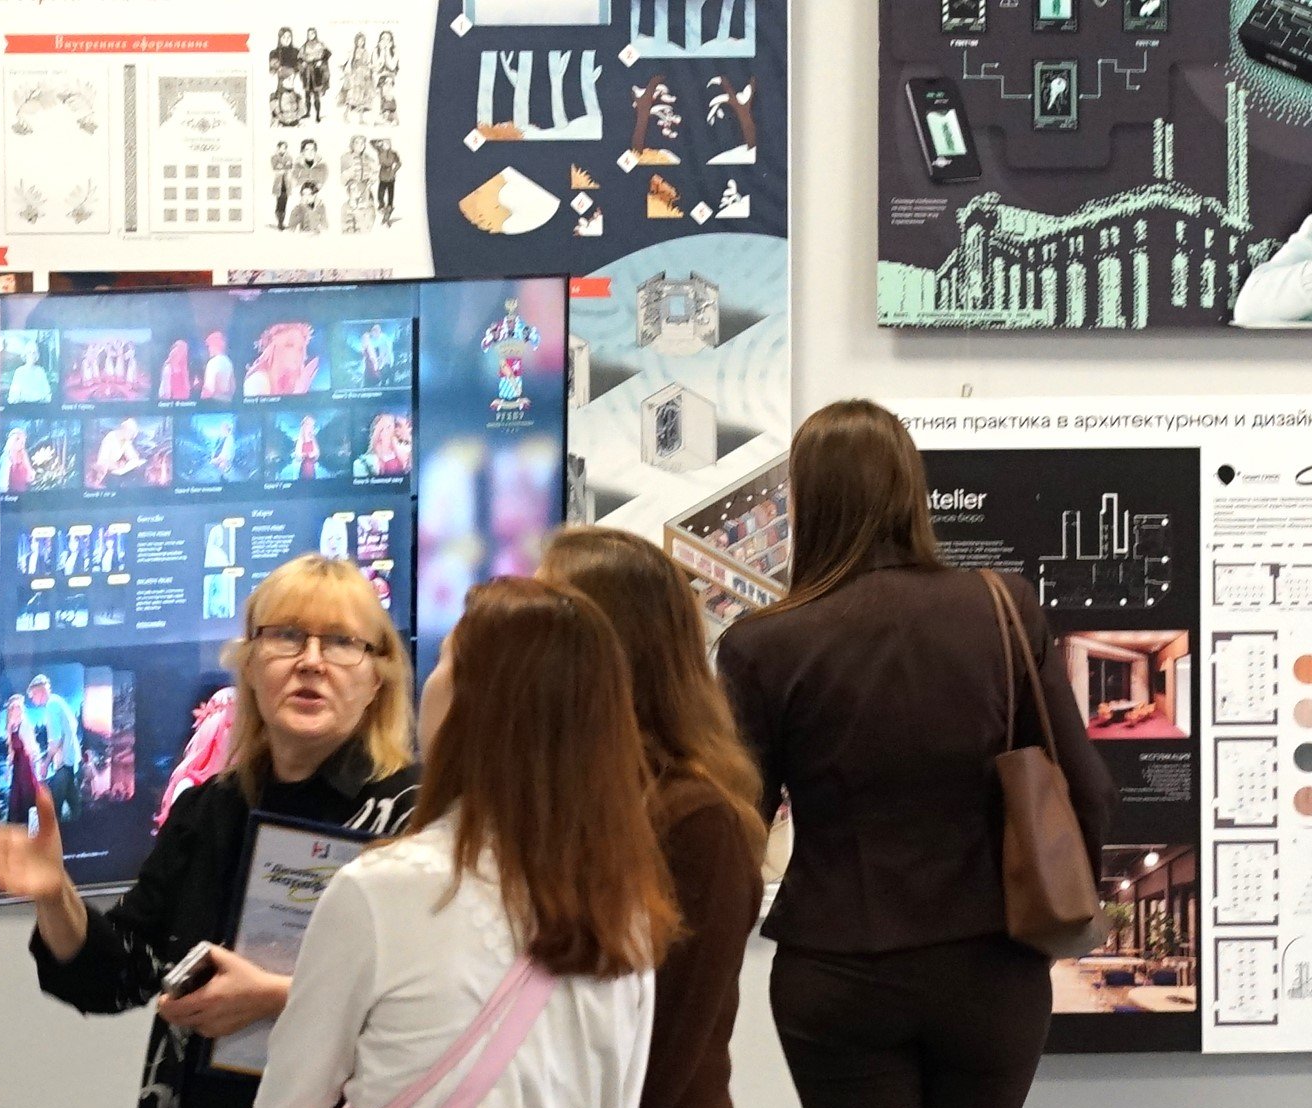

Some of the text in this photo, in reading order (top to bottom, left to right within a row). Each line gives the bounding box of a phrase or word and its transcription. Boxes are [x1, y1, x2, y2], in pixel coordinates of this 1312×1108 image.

[894, 413, 957, 430] етняя
[962, 414, 1051, 433] практика
[1056, 414, 1069, 428] в
[1073, 411, 1229, 433] архитектурном
[1234, 412, 1247, 427] и
